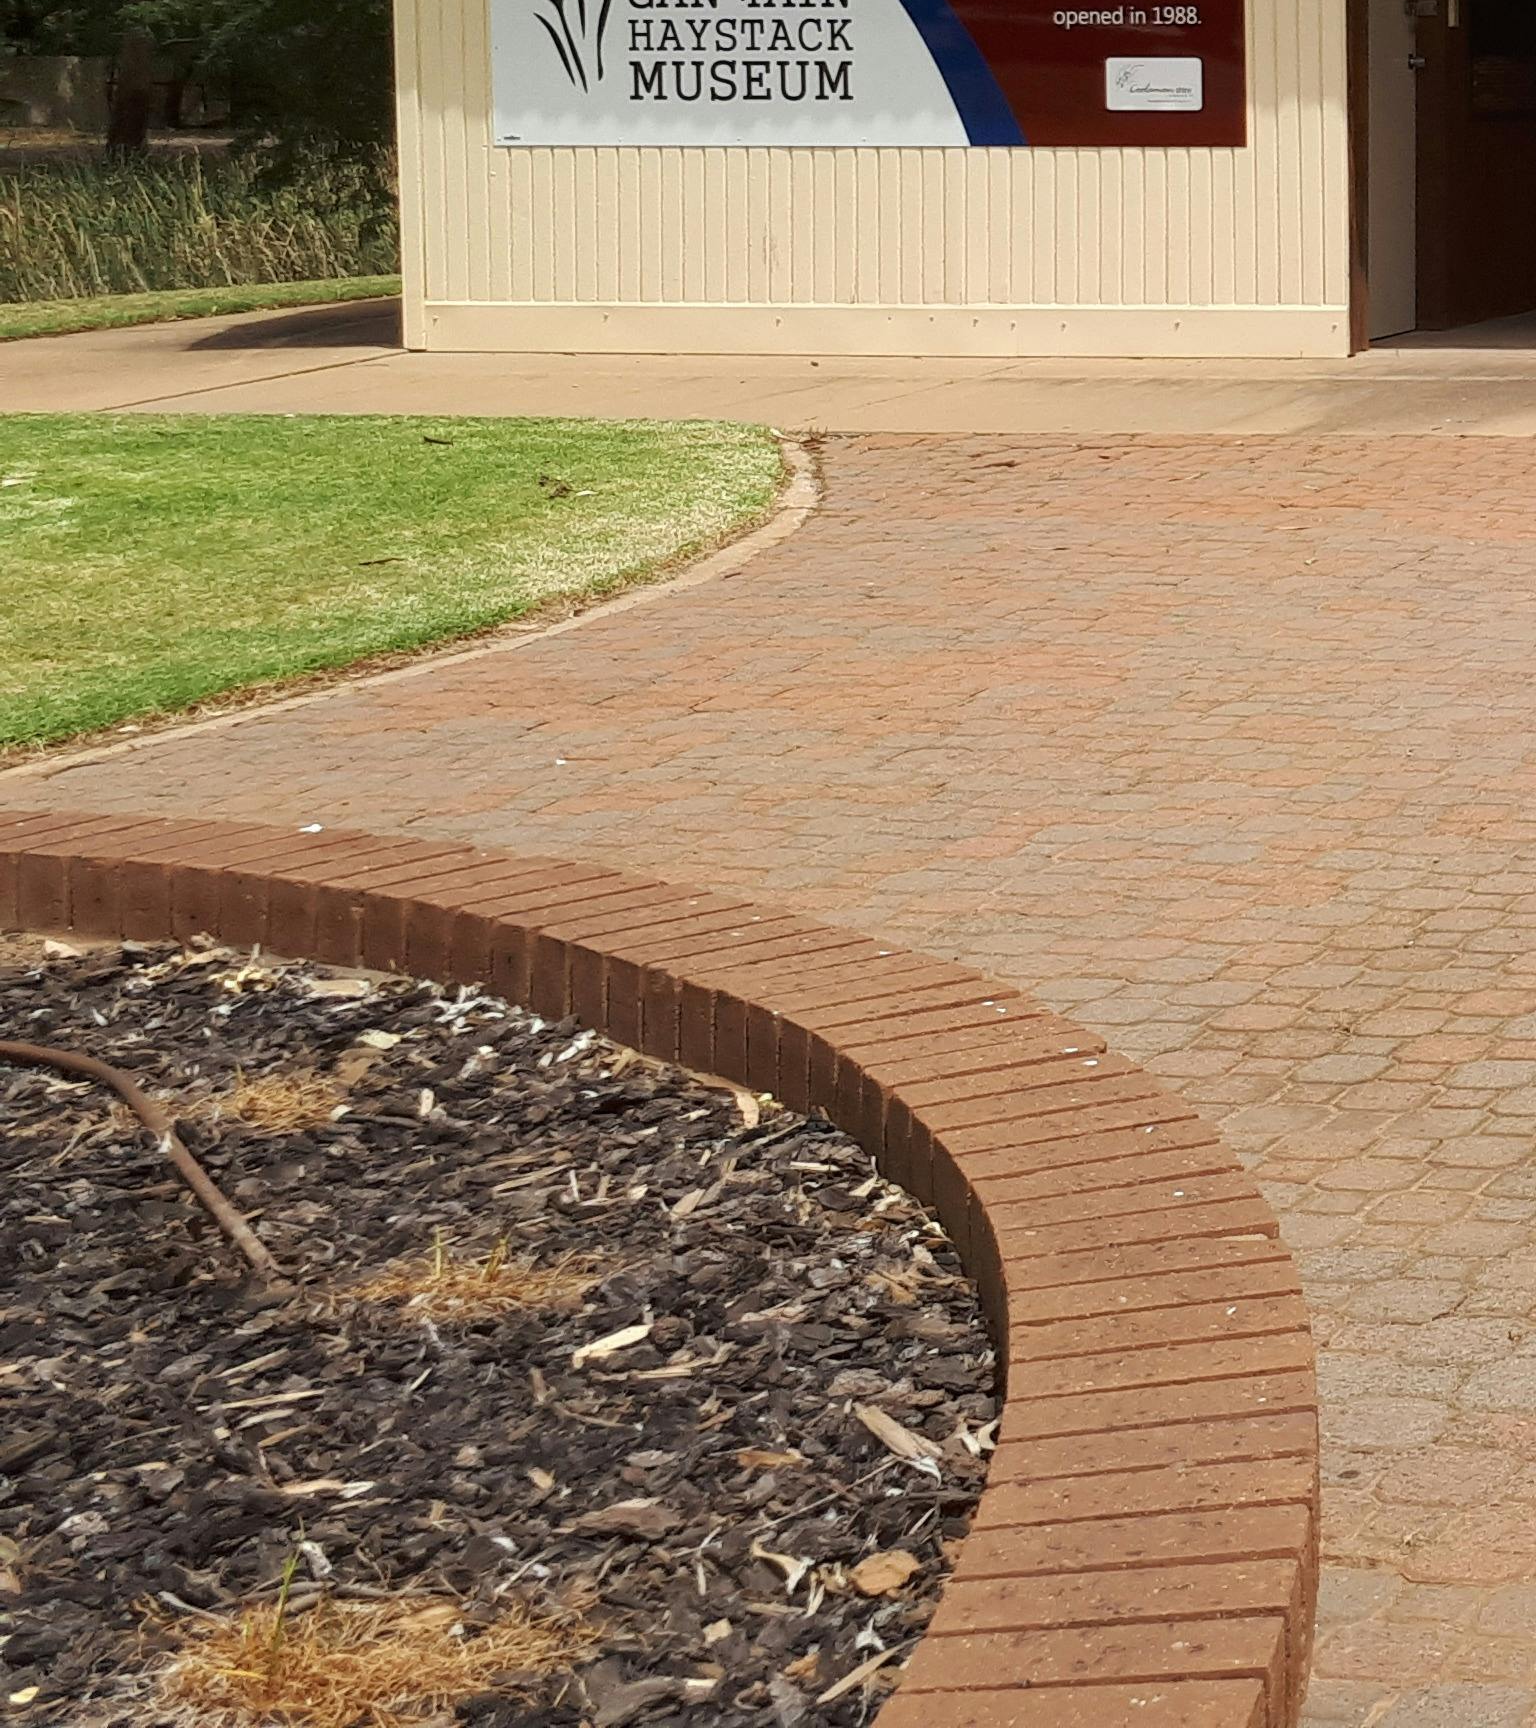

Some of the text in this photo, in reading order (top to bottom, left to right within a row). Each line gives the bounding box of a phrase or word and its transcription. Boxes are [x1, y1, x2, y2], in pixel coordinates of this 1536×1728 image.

[1053, 6, 1201, 29] opened in 1988.
[628, 19, 853, 51] HAYSTACK
[629, 60, 853, 101] MUSEUM
